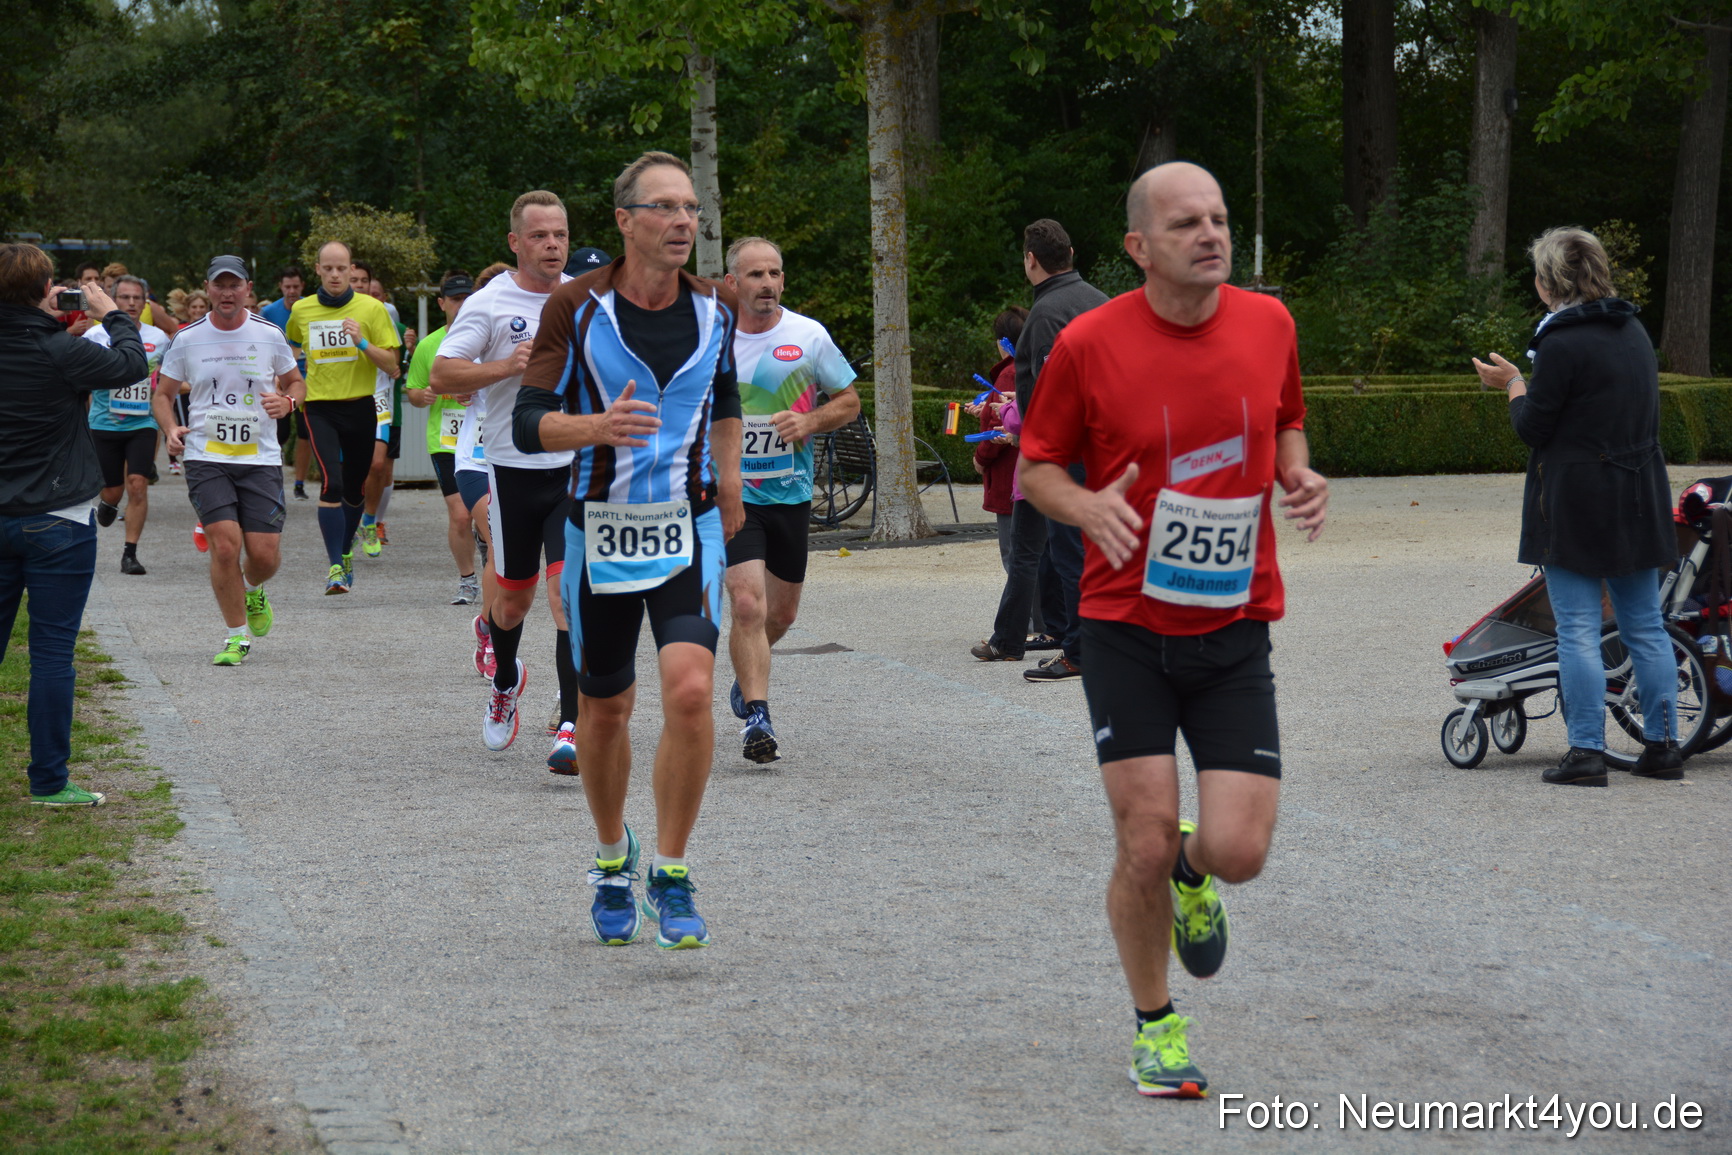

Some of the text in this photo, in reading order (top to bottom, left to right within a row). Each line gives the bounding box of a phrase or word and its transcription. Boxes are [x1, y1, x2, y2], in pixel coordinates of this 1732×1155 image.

[319, 330, 347, 347] 168
[510, 331, 532, 340] PARTL
[319, 350, 348, 358] Christian
[776, 349, 800, 357] Hervis
[114, 386, 148, 400] 2815
[119, 402, 142, 410] Michael
[216, 423, 251, 442] 516
[740, 431, 788, 454] 274
[744, 460, 775, 470] Hubert
[1190, 450, 1224, 470] DEHN
[588, 511, 673, 521] PARTL Neumarkt
[1159, 500, 1252, 521] PARTL Neumarkt
[597, 523, 683, 557] 3058
[1161, 520, 1252, 566] 2554
[1167, 571, 1239, 592] Johannes
